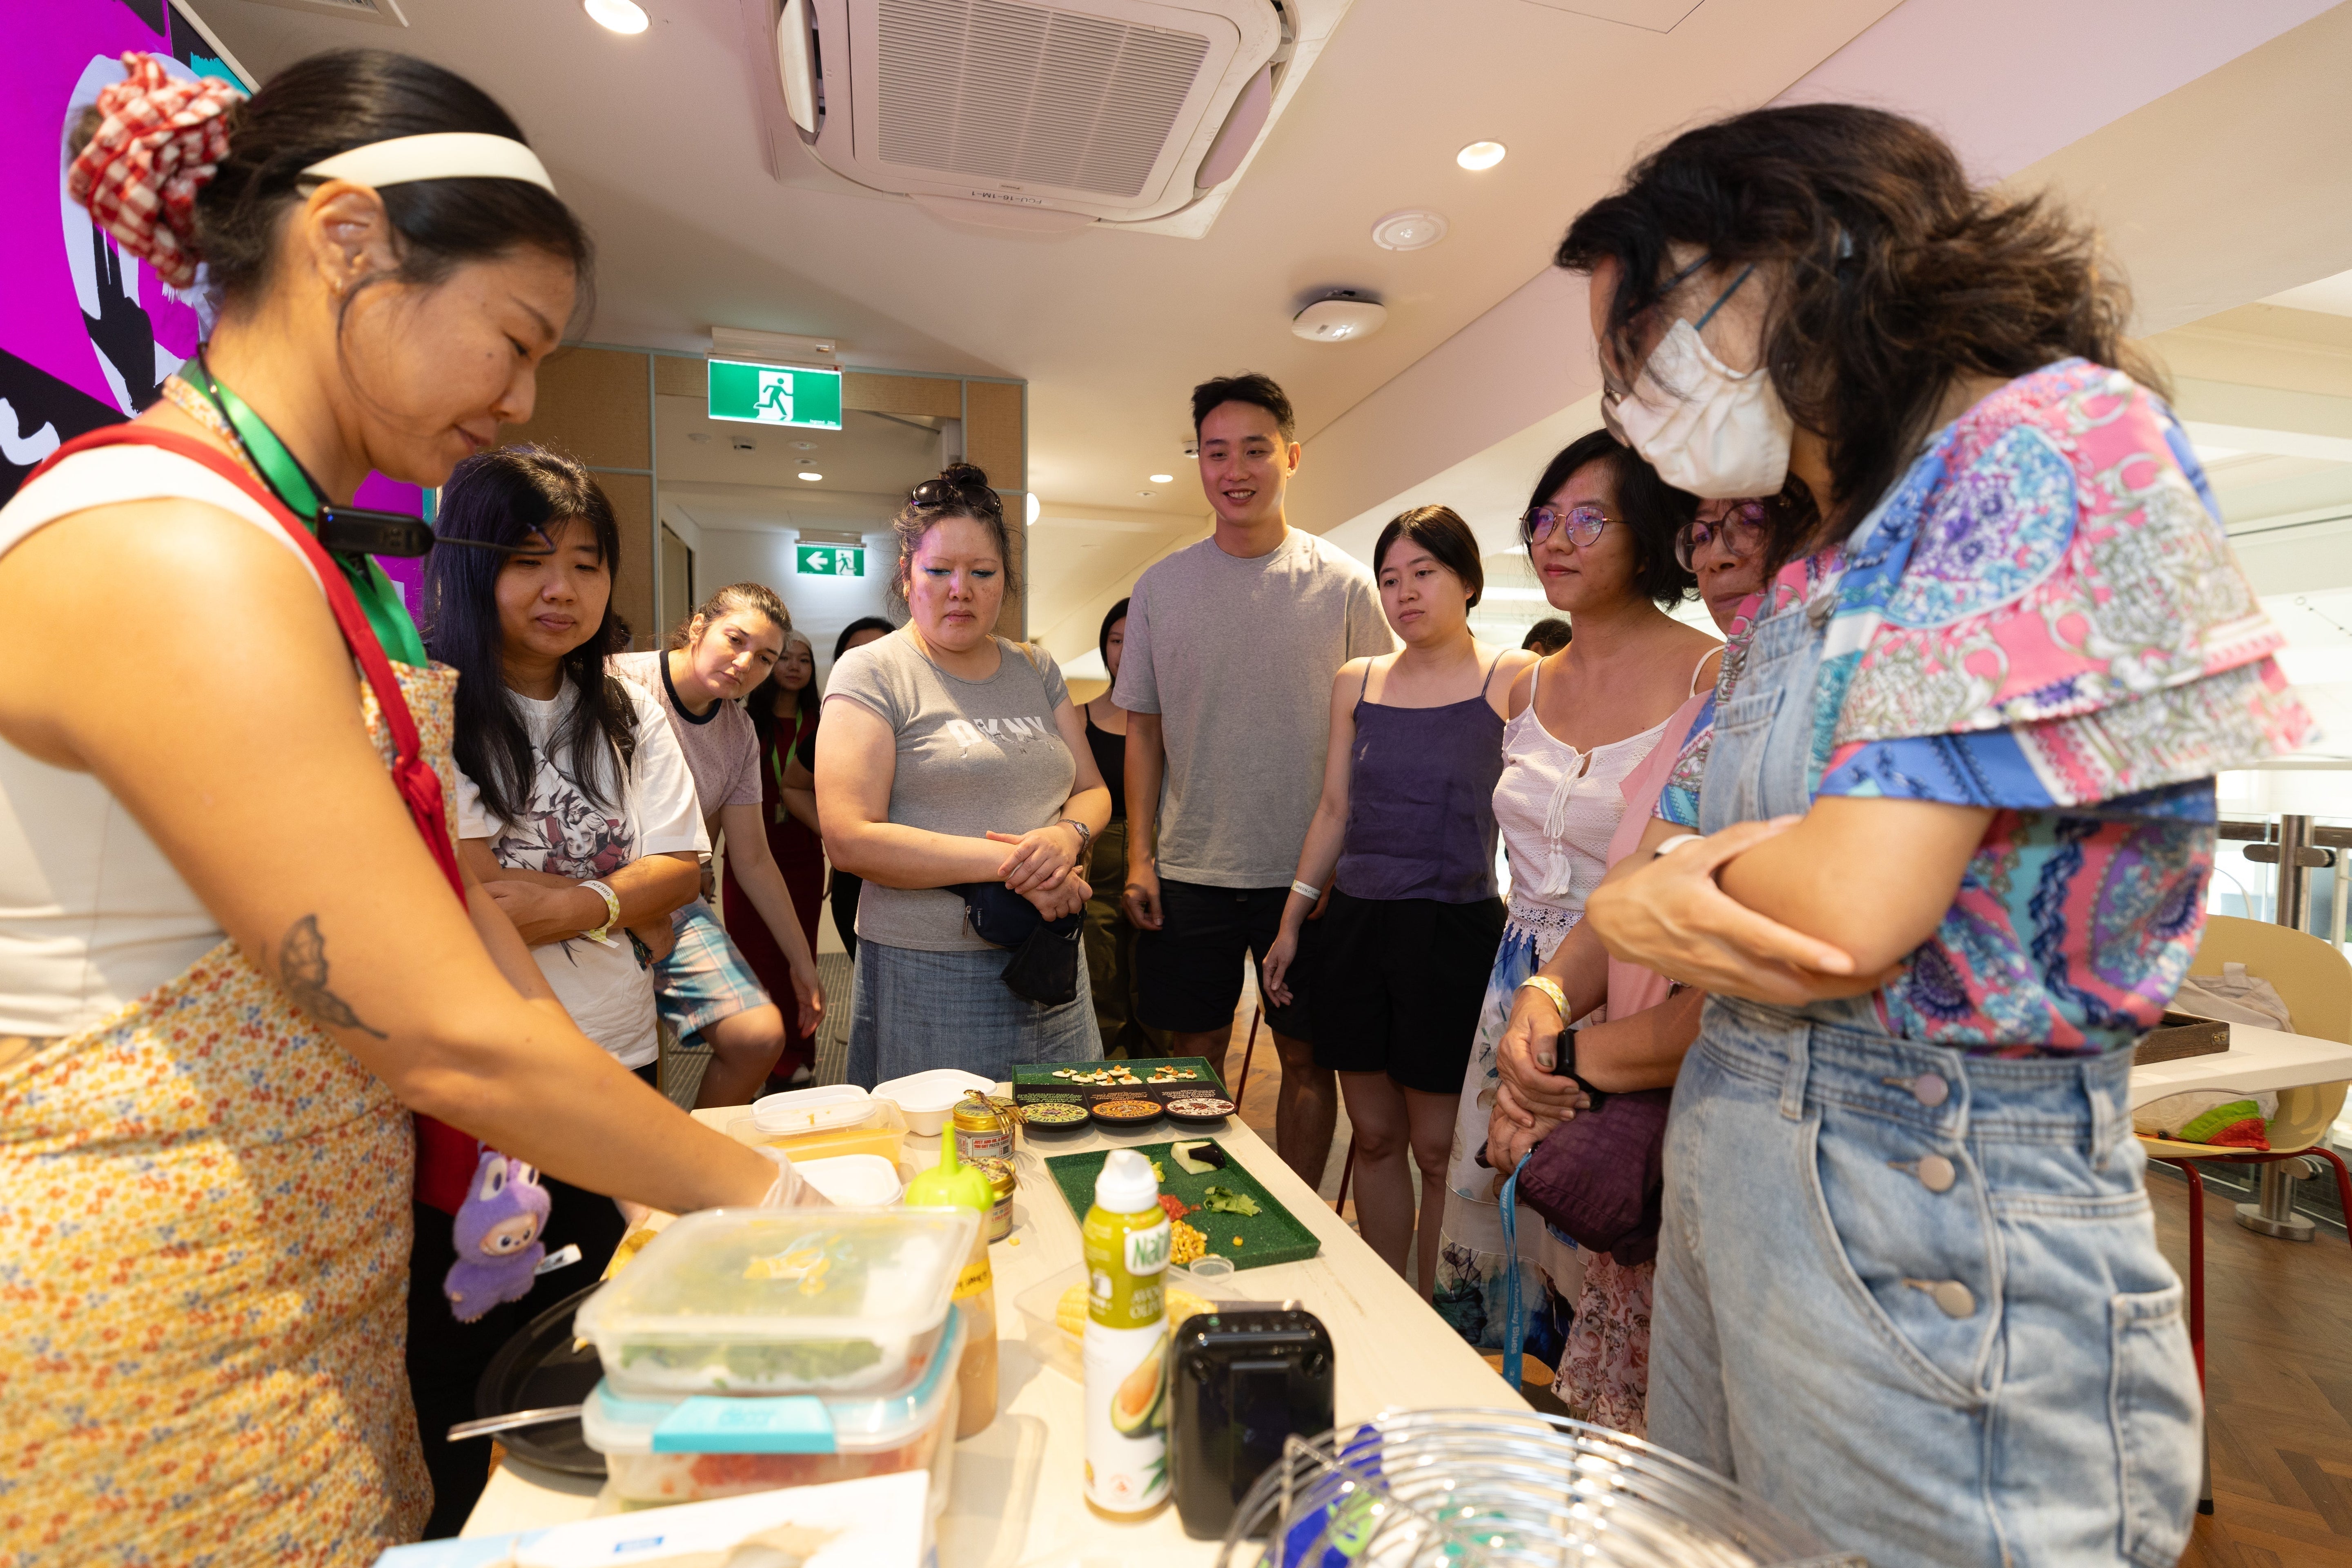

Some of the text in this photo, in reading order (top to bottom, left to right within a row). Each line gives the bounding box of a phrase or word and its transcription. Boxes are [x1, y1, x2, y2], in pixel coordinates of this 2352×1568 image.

[971, 191, 1042, 204] FCU-16-1M-1
[945, 716, 1061, 747] DKNY
[591, 883, 610, 896] GREEN
[1295, 884, 1308, 893] GREEN
[1511, 1326, 1520, 1354] Blues
